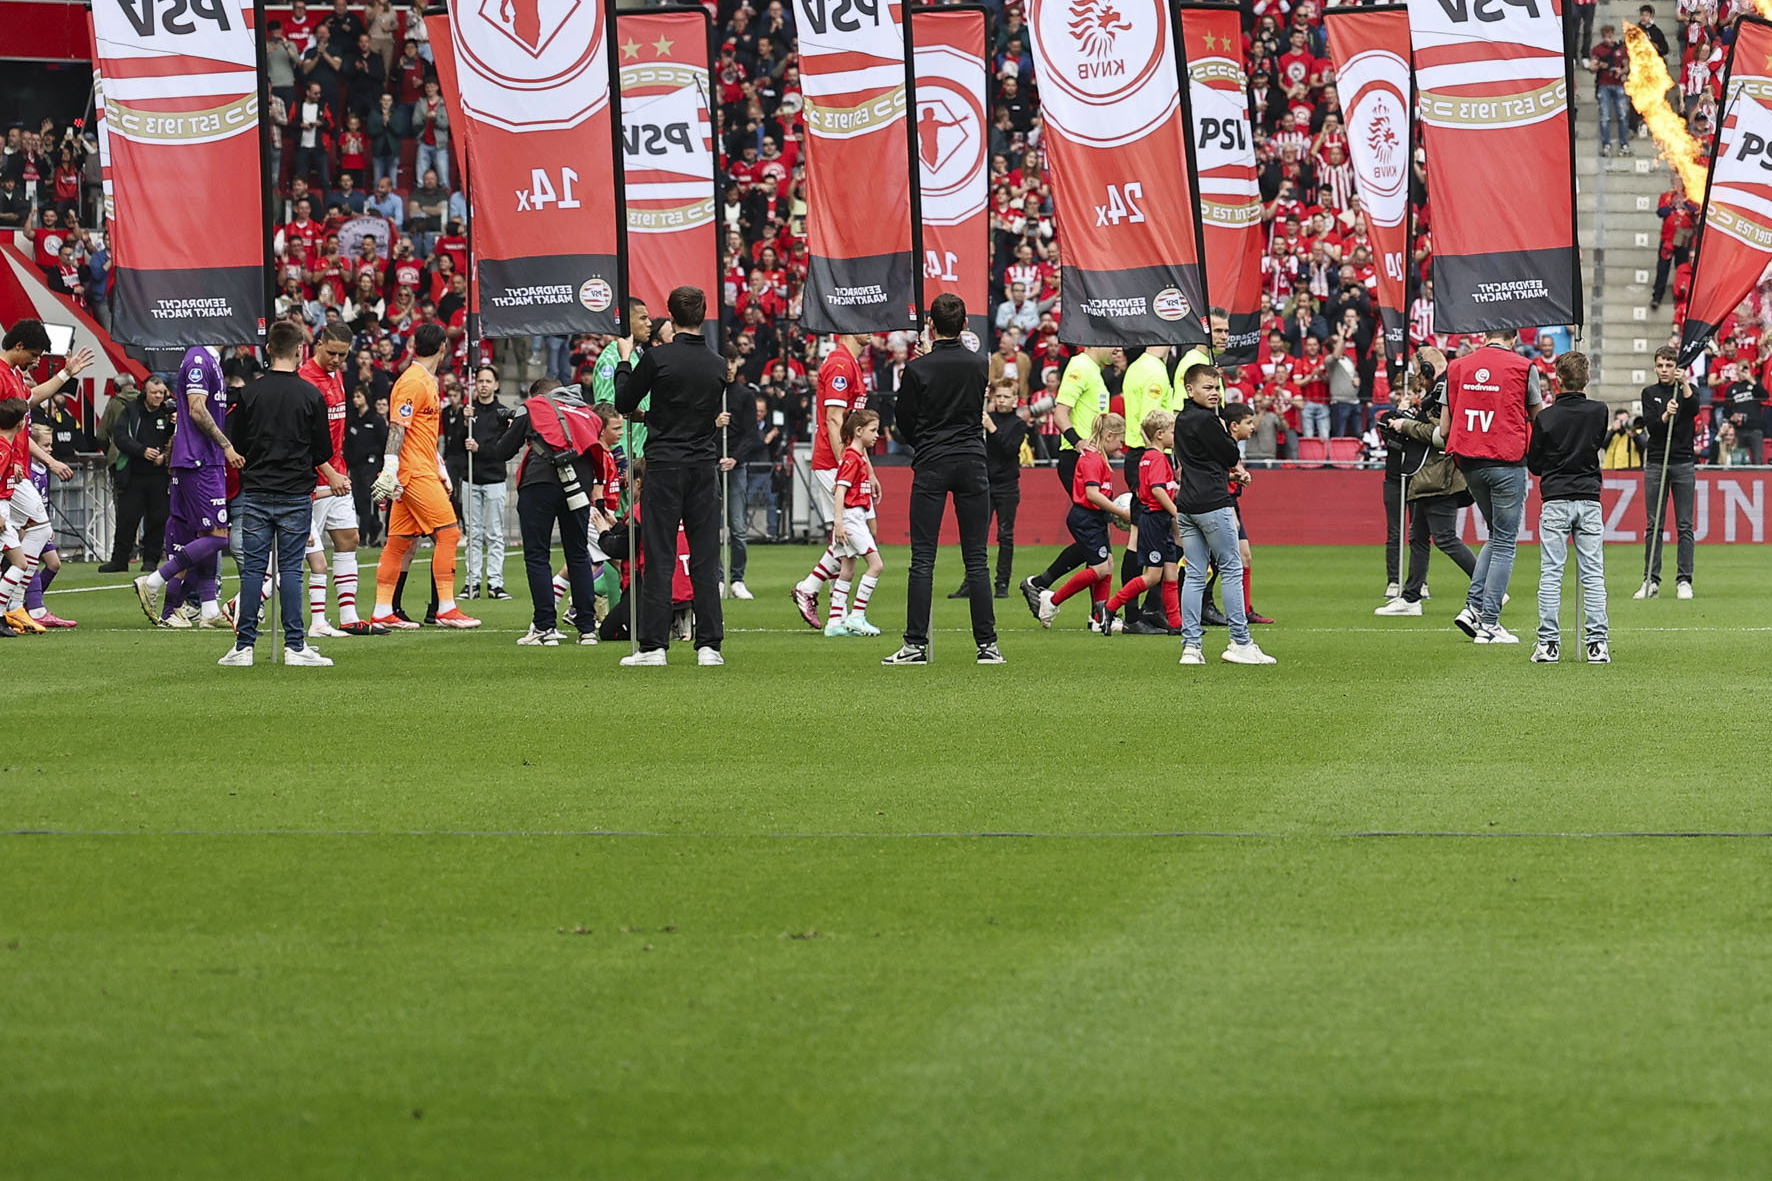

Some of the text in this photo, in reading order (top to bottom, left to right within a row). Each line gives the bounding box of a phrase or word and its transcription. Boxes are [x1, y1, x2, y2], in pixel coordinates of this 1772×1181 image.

[1198, 117, 1246, 151] PSV
[1735, 218, 1753, 238] EST
[1464, 408, 1495, 433] TV
[1604, 480, 1767, 543] ZJN
[679, 554, 691, 576] T
